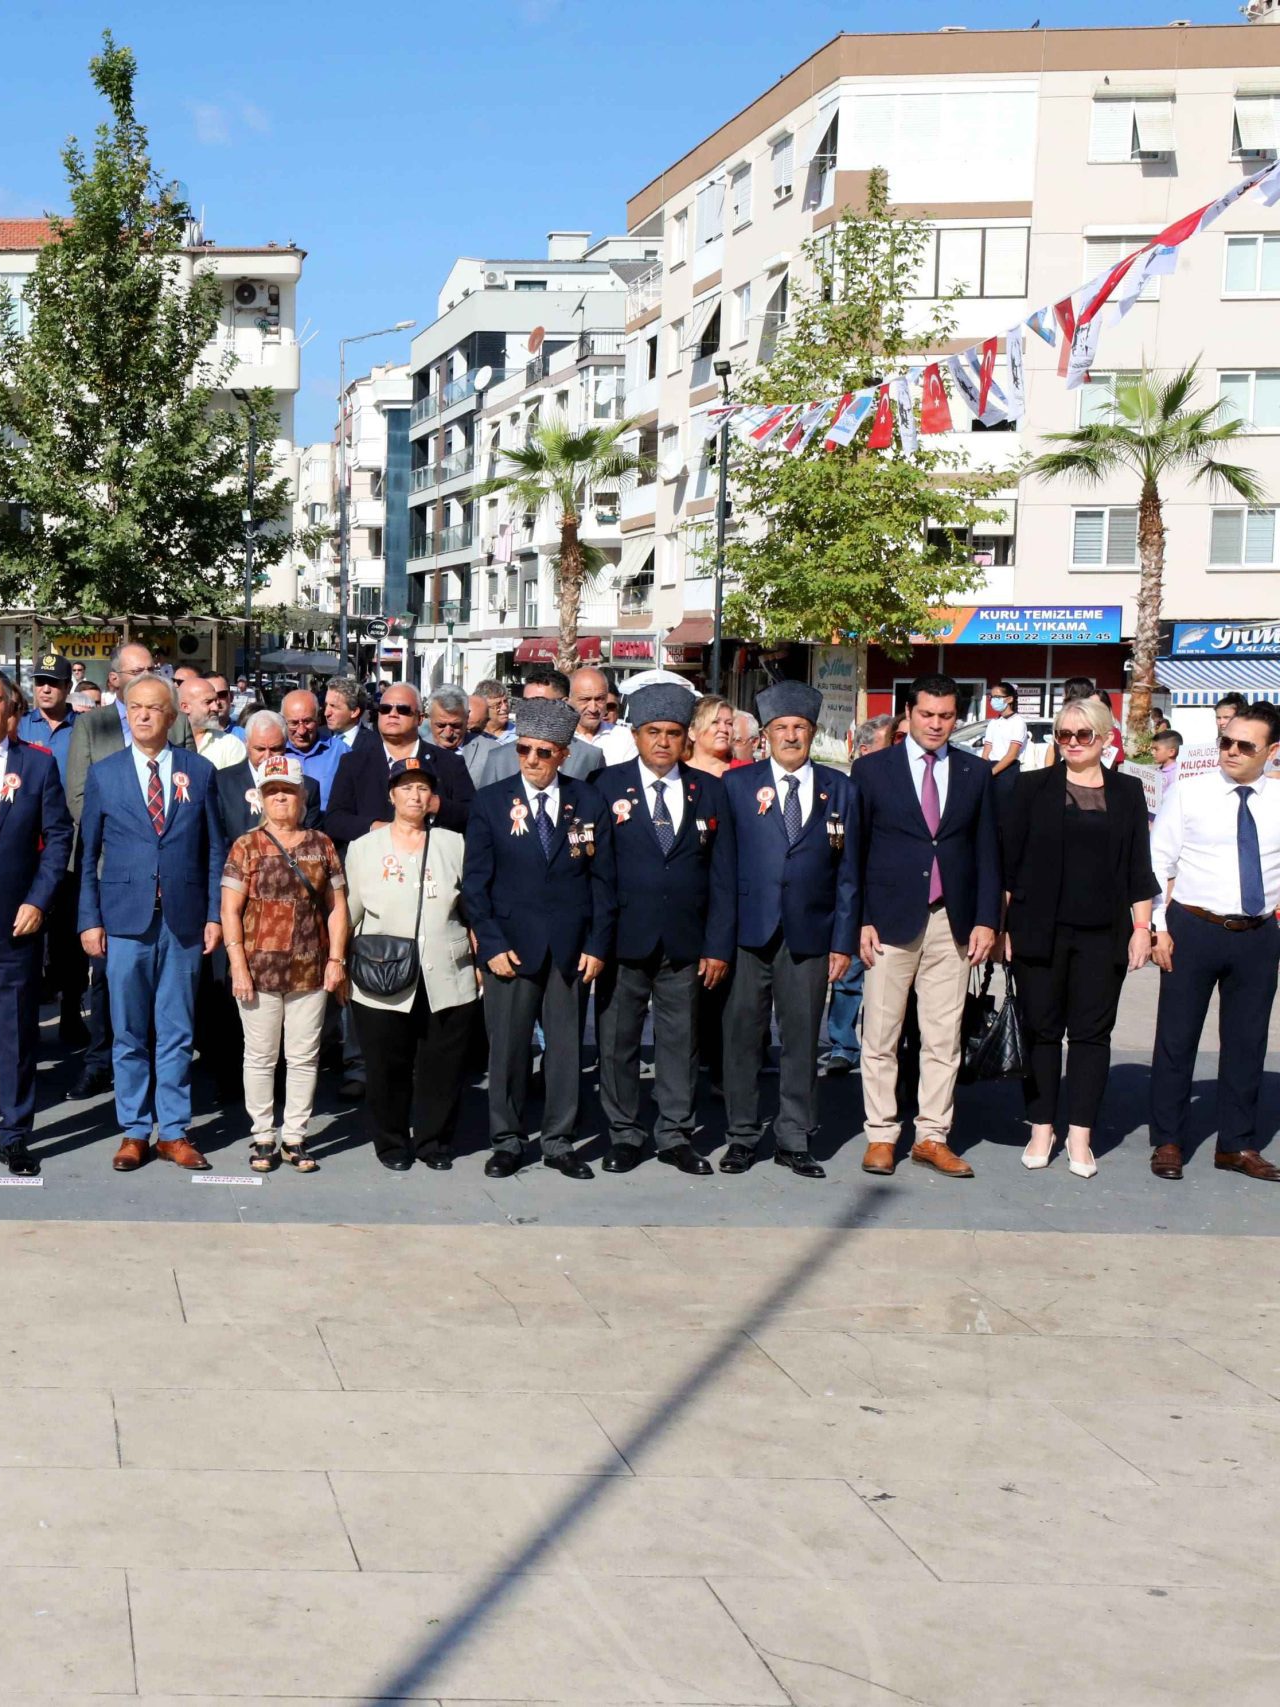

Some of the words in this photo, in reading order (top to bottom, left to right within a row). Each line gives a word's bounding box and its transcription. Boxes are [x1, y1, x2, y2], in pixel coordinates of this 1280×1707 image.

[979, 610, 1020, 620] KURU
[995, 622, 1028, 631] HALI
[1033, 622, 1088, 631] YIKAMA
[1180, 759, 1220, 770] KILIÇASLA
[1143, 783, 1156, 795] HAN
